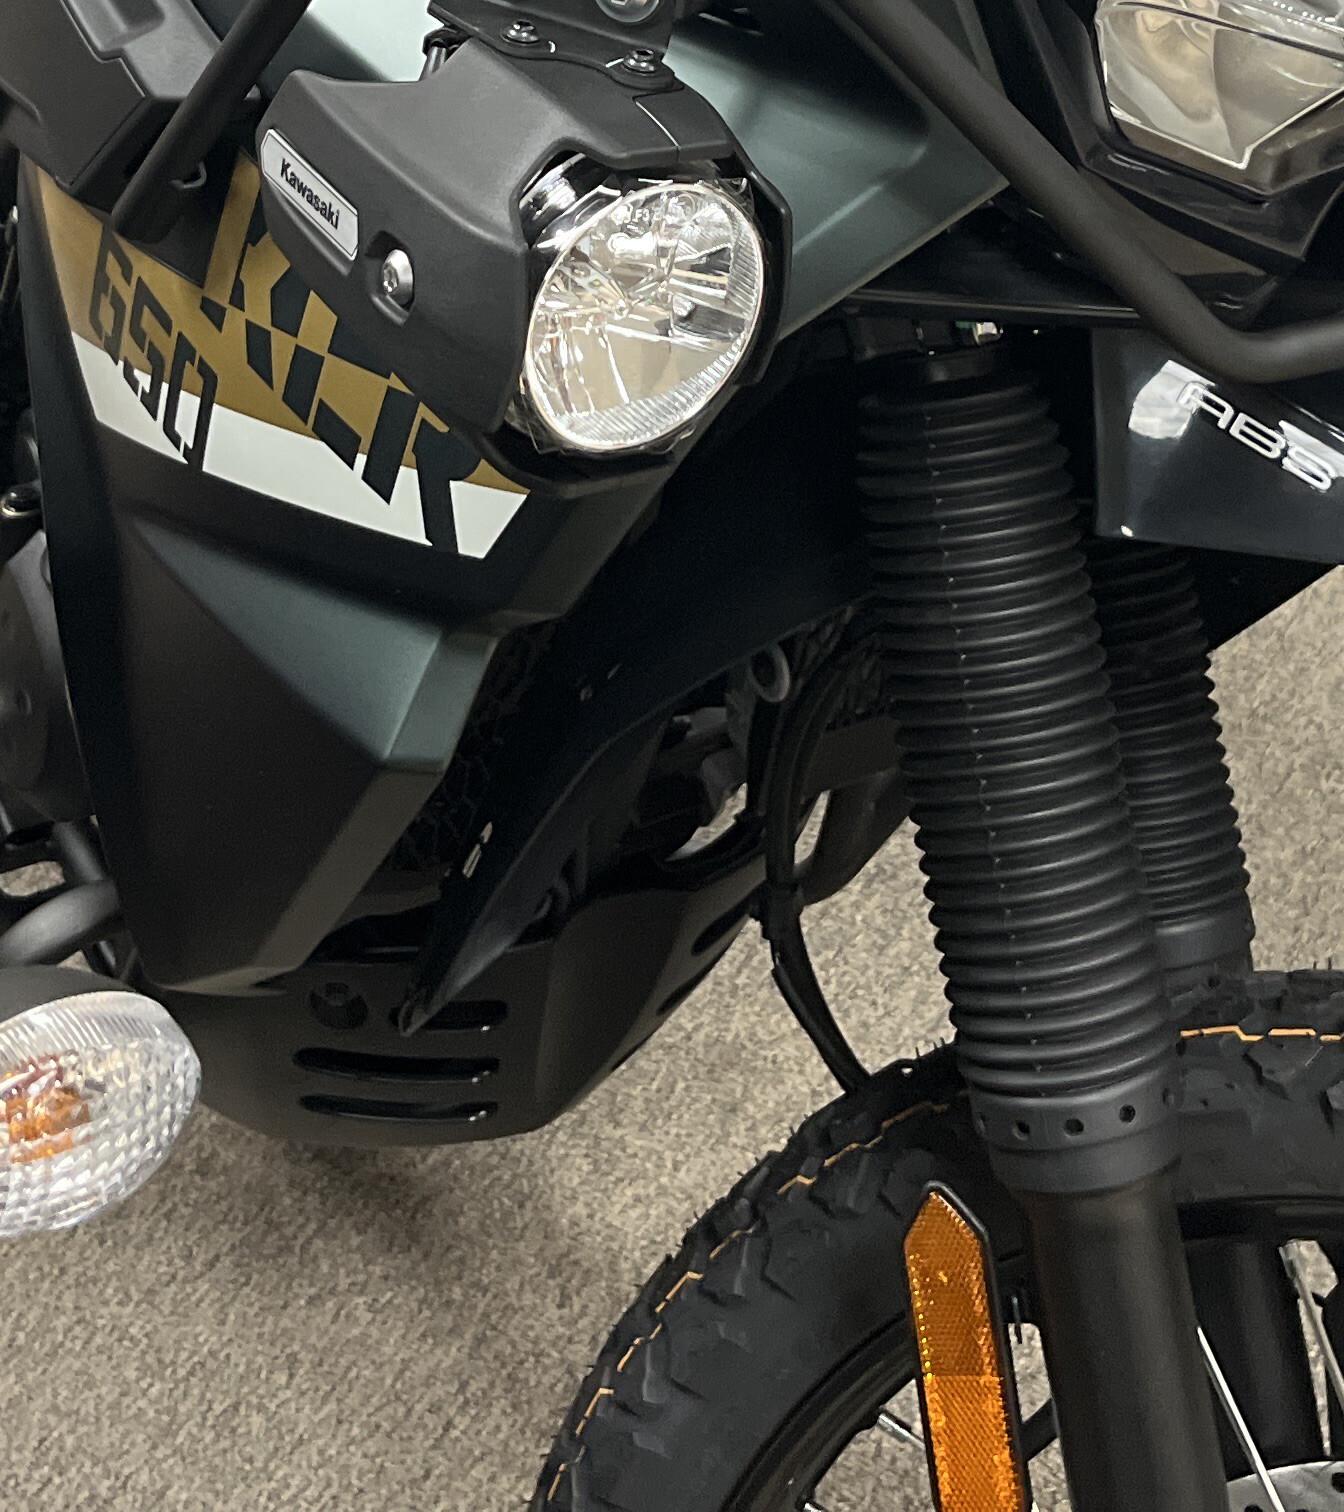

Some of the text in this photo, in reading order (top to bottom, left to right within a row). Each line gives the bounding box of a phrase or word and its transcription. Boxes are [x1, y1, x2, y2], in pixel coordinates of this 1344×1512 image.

[280, 157, 340, 230] Kawasaki
[88, 225, 219, 473] 650
[1177, 381, 1338, 492] ABS
